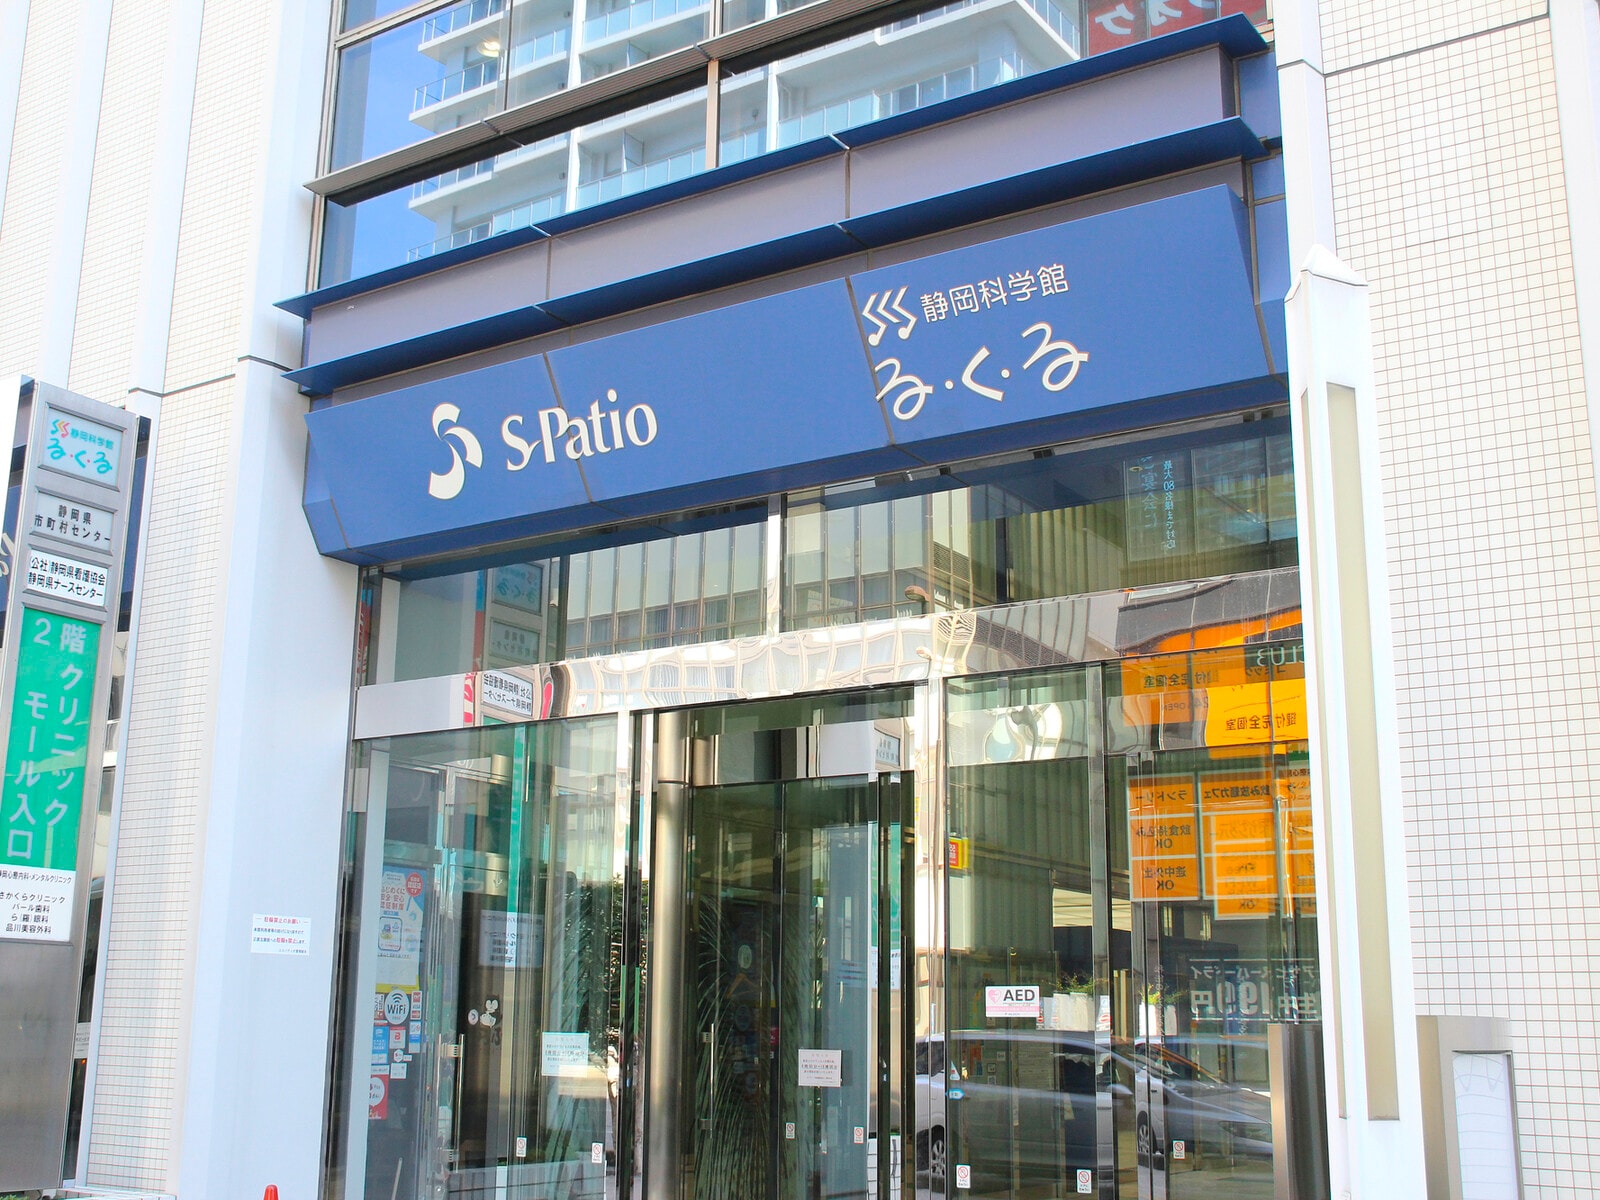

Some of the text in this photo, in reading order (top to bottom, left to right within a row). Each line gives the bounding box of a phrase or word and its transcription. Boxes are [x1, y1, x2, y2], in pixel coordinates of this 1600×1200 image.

[920, 264, 1069, 323] 静岡科学館
[875, 321, 1089, 420] る・く・る
[58, 504, 92, 525] 静岡県
[34, 514, 111, 541] 市町村センター
[27, 571, 103, 598] 静岡県ナースセンター
[5, 923, 52, 934] 品川美容外科
[1003, 989, 1036, 1002] AED
[387, 1004, 406, 1015] WiFi
